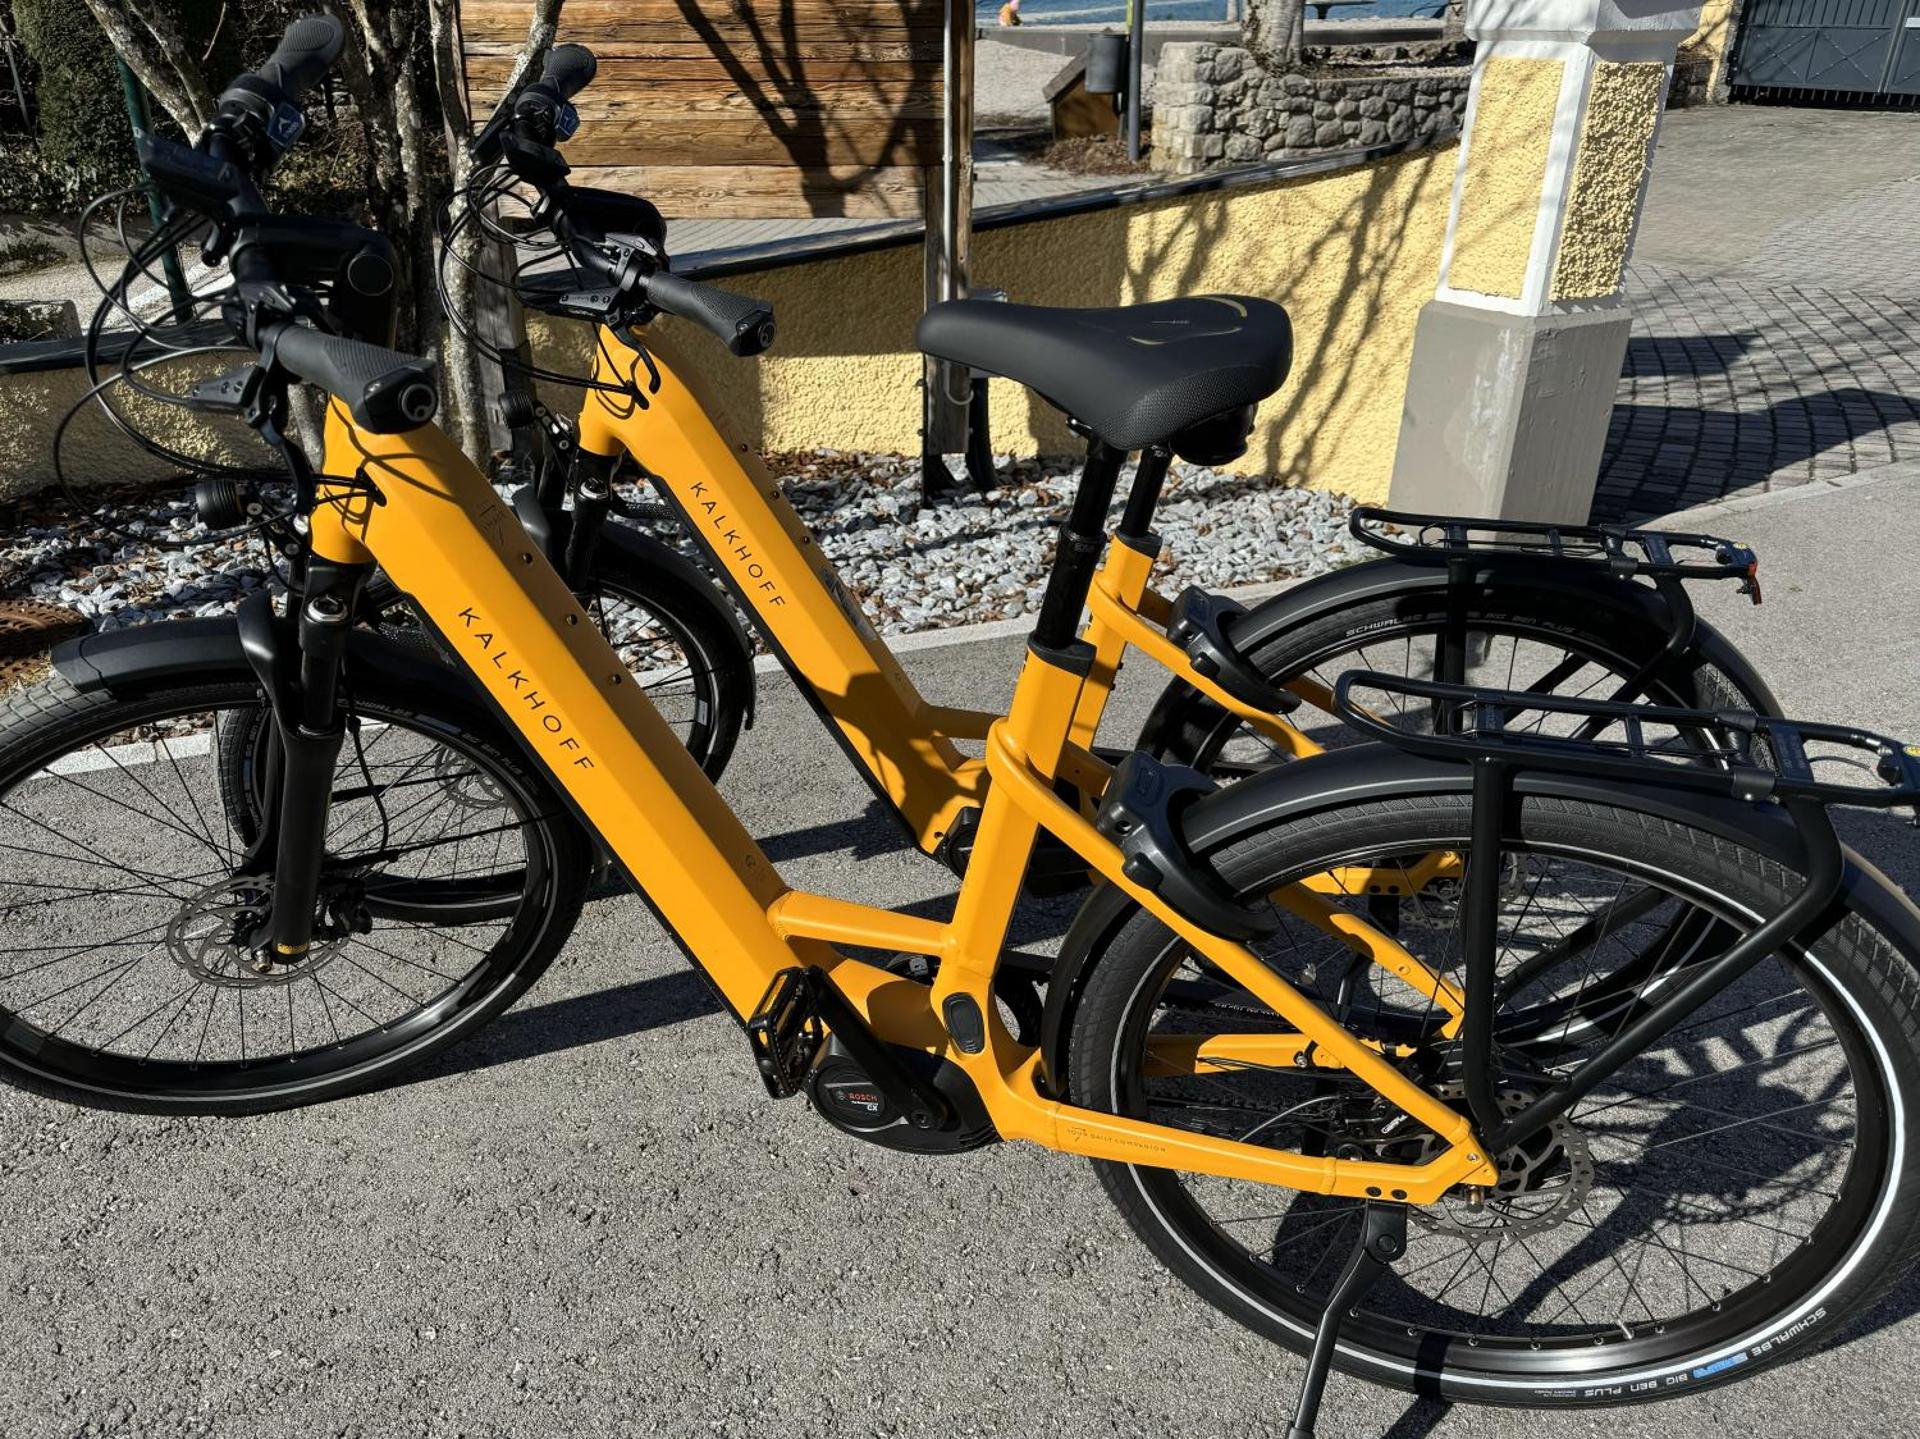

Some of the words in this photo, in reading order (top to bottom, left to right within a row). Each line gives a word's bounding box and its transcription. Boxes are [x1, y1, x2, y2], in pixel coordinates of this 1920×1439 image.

[690, 482, 785, 606] KALKHOFF
[458, 607, 594, 768] KALKHOFF
[848, 1091, 878, 1102] BOSCH
[1751, 1306, 1827, 1357] SCHWALBE
[1583, 1385, 1622, 1397] PLUS
[1665, 1373, 1688, 1385] BIG
